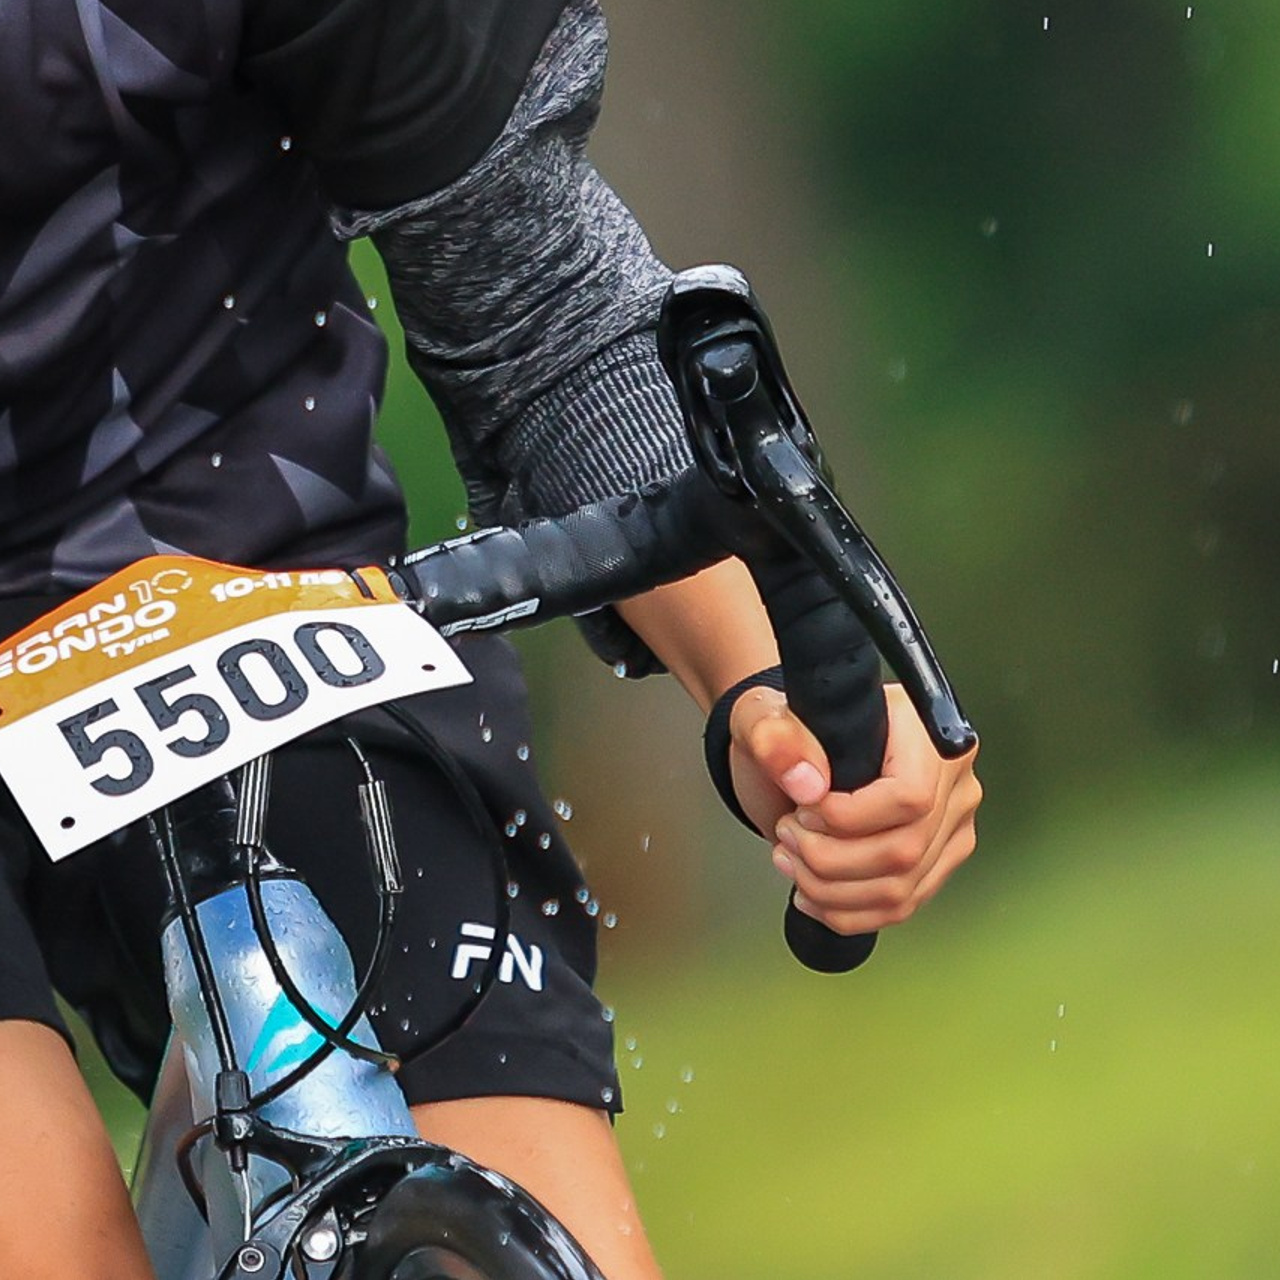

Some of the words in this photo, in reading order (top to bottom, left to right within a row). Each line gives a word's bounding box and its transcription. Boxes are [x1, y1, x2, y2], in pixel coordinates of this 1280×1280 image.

[209, 572, 293, 603] 10-11
[56, 620, 387, 798] 5500
[450, 921, 544, 992] FN
